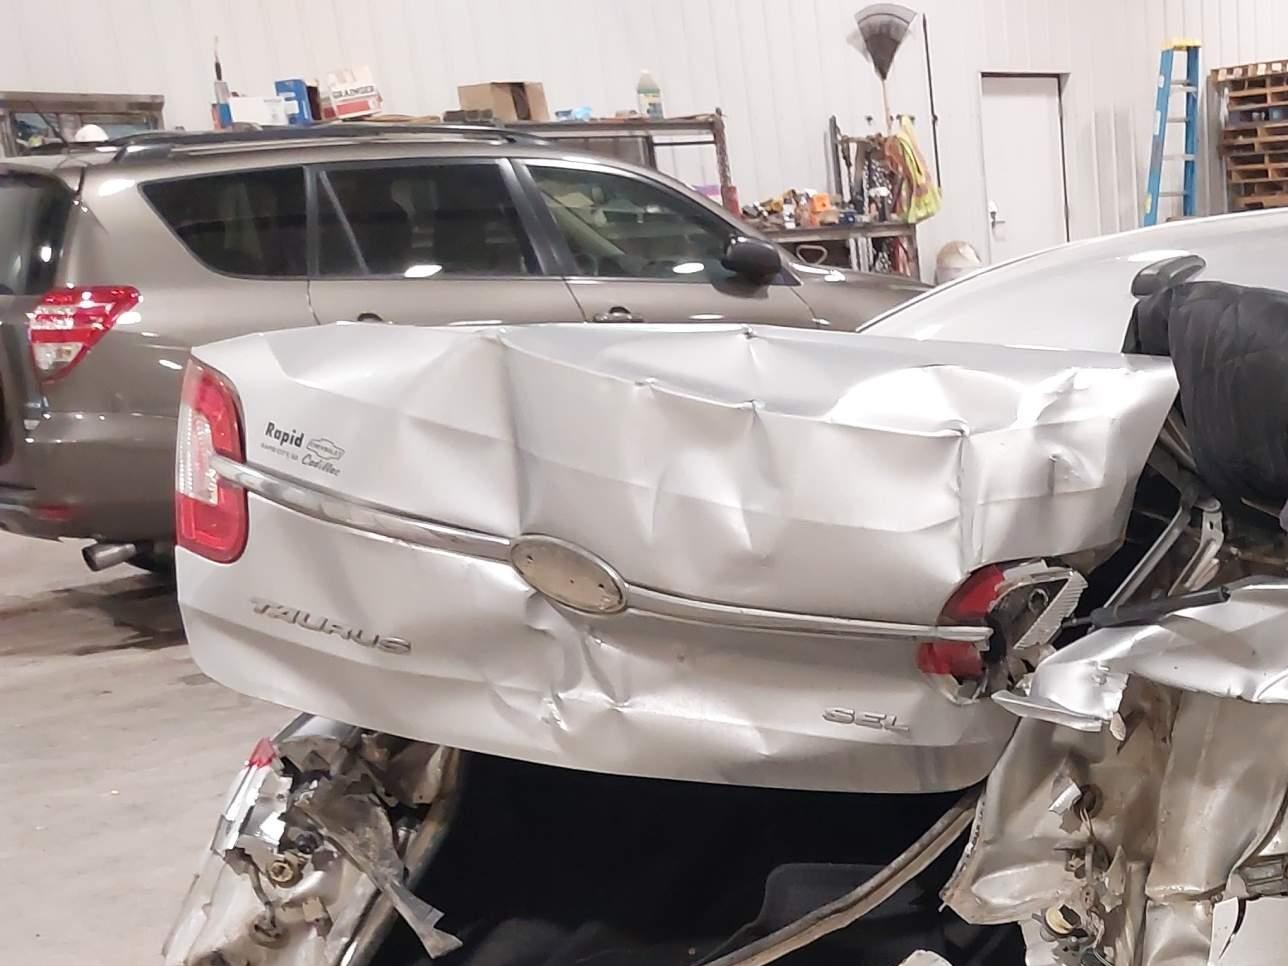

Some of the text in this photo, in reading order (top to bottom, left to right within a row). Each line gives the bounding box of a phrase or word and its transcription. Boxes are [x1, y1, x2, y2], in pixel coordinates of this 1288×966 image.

[264, 421, 305, 448] Rapid
[301, 453, 341, 476] Cadillac
[251, 598, 412, 655] TAURUS
[822, 706, 911, 731] SEL
